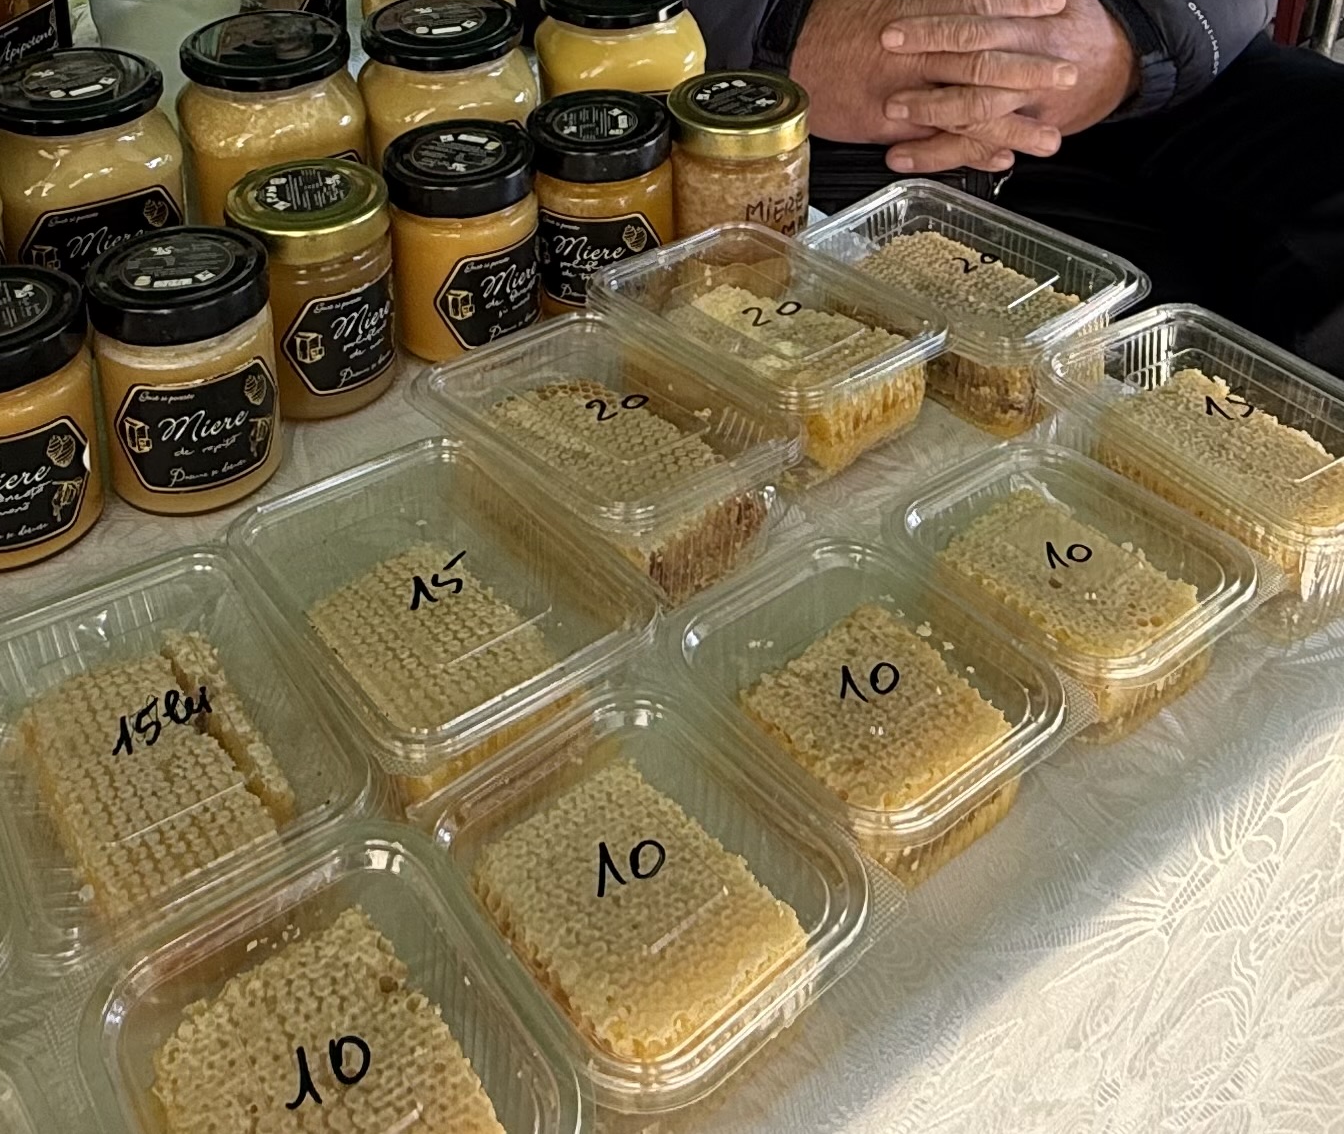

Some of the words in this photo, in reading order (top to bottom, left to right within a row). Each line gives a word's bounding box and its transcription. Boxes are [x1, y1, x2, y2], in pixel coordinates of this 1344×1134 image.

[553, 235, 626, 260] Miere
[952, 253, 998, 273] 20
[742, 301, 802, 327] 20
[585, 392, 651, 423] 20
[158, 410, 249, 442] Miere
[1045, 539, 1095, 570] 10
[409, 550, 469, 612] 15
[839, 661, 900, 701] 10
[597, 840, 666, 897] 10
[286, 1035, 371, 1110] 10
